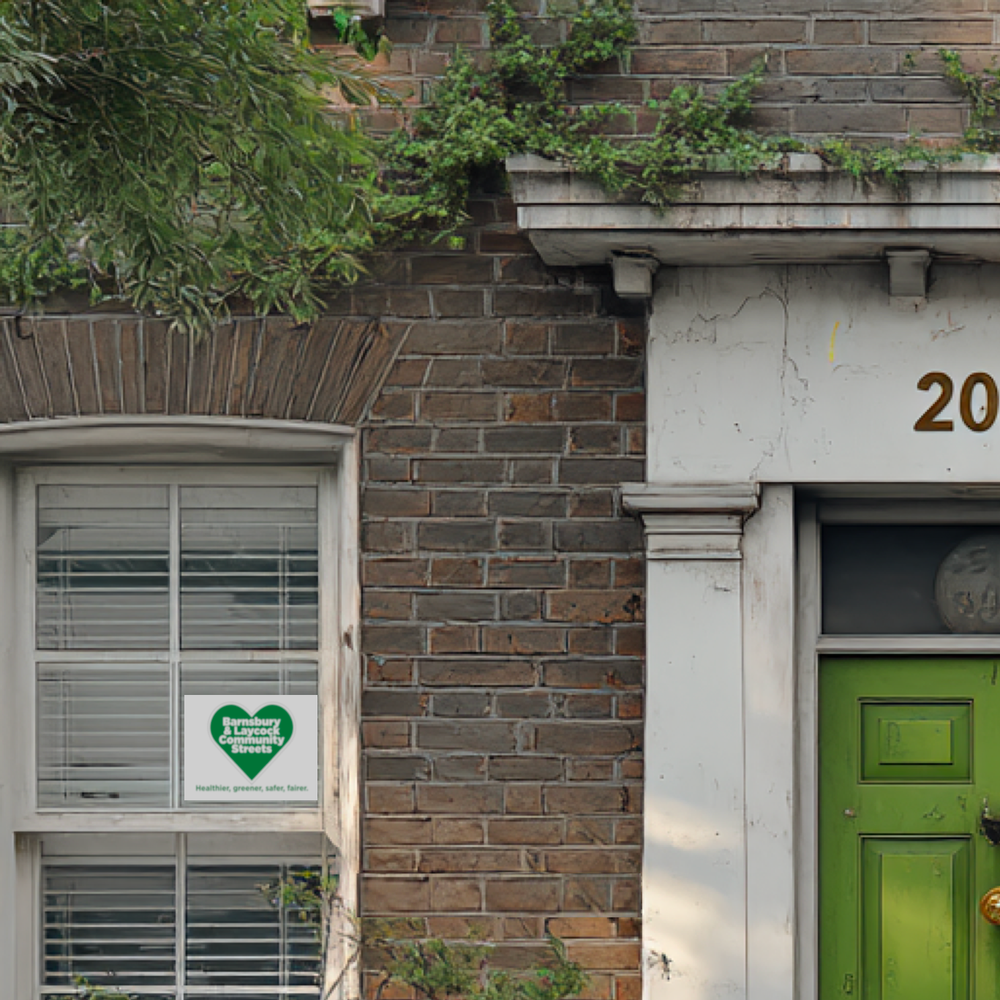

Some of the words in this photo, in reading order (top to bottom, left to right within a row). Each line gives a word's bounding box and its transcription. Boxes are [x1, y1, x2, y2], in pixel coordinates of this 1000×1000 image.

[222, 716, 281, 727] Barnsbury
[223, 726, 232, 735] &
[233, 725, 280, 737] Laycock
[218, 735, 285, 746] Community
[231, 744, 272, 753] Streets
[195, 784, 231, 792] Healthier,
[232, 785, 264, 793] greener,
[265, 784, 286, 793] safer,
[287, 784, 309, 792] fairer.
